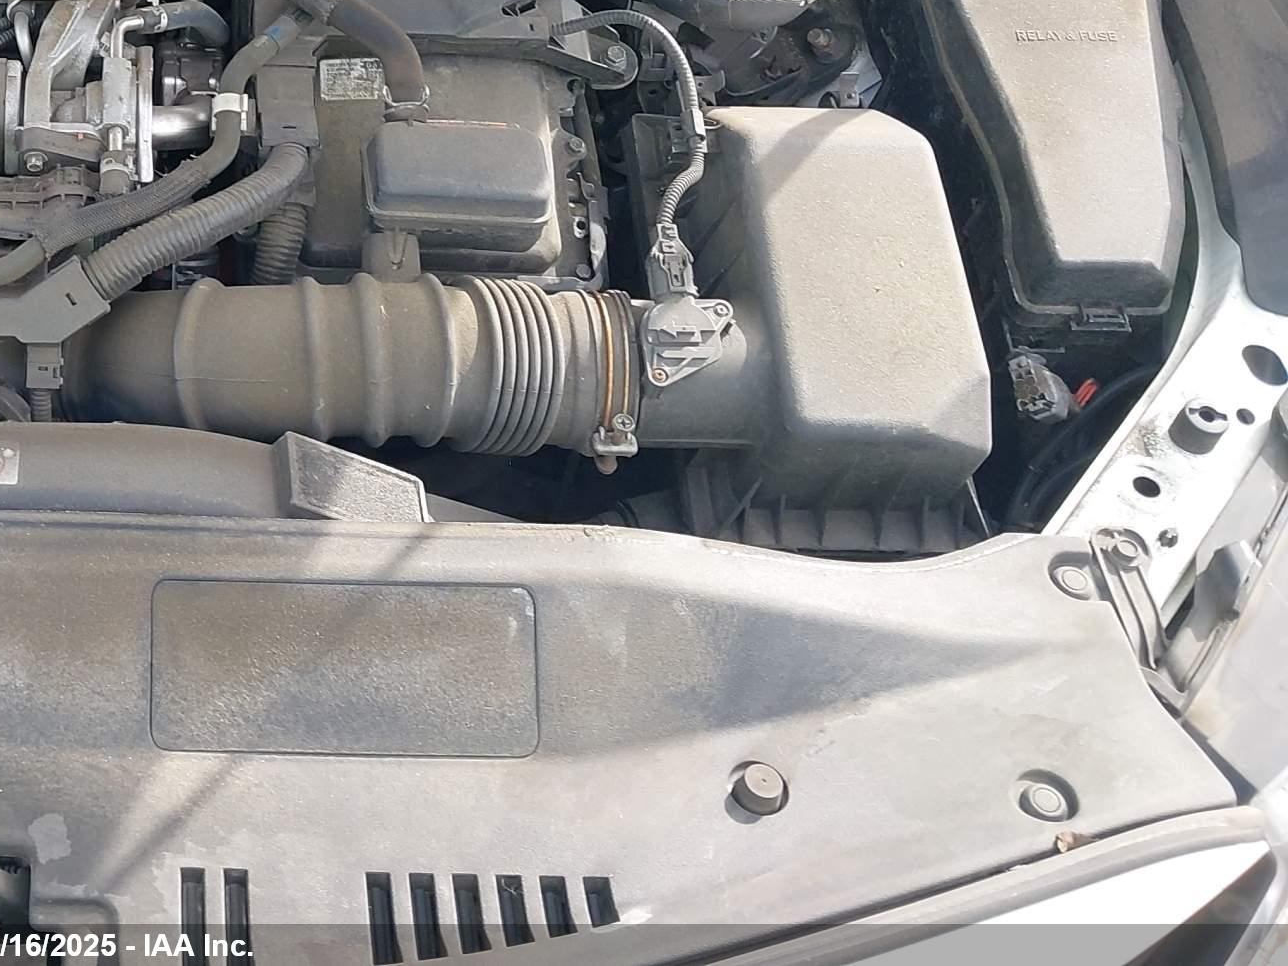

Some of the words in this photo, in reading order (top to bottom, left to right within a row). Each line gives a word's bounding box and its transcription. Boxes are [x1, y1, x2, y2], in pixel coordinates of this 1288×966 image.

[1015, 29, 1062, 42] RELAY
[1065, 32, 1076, 42] &
[1079, 30, 1118, 42] FUSE
